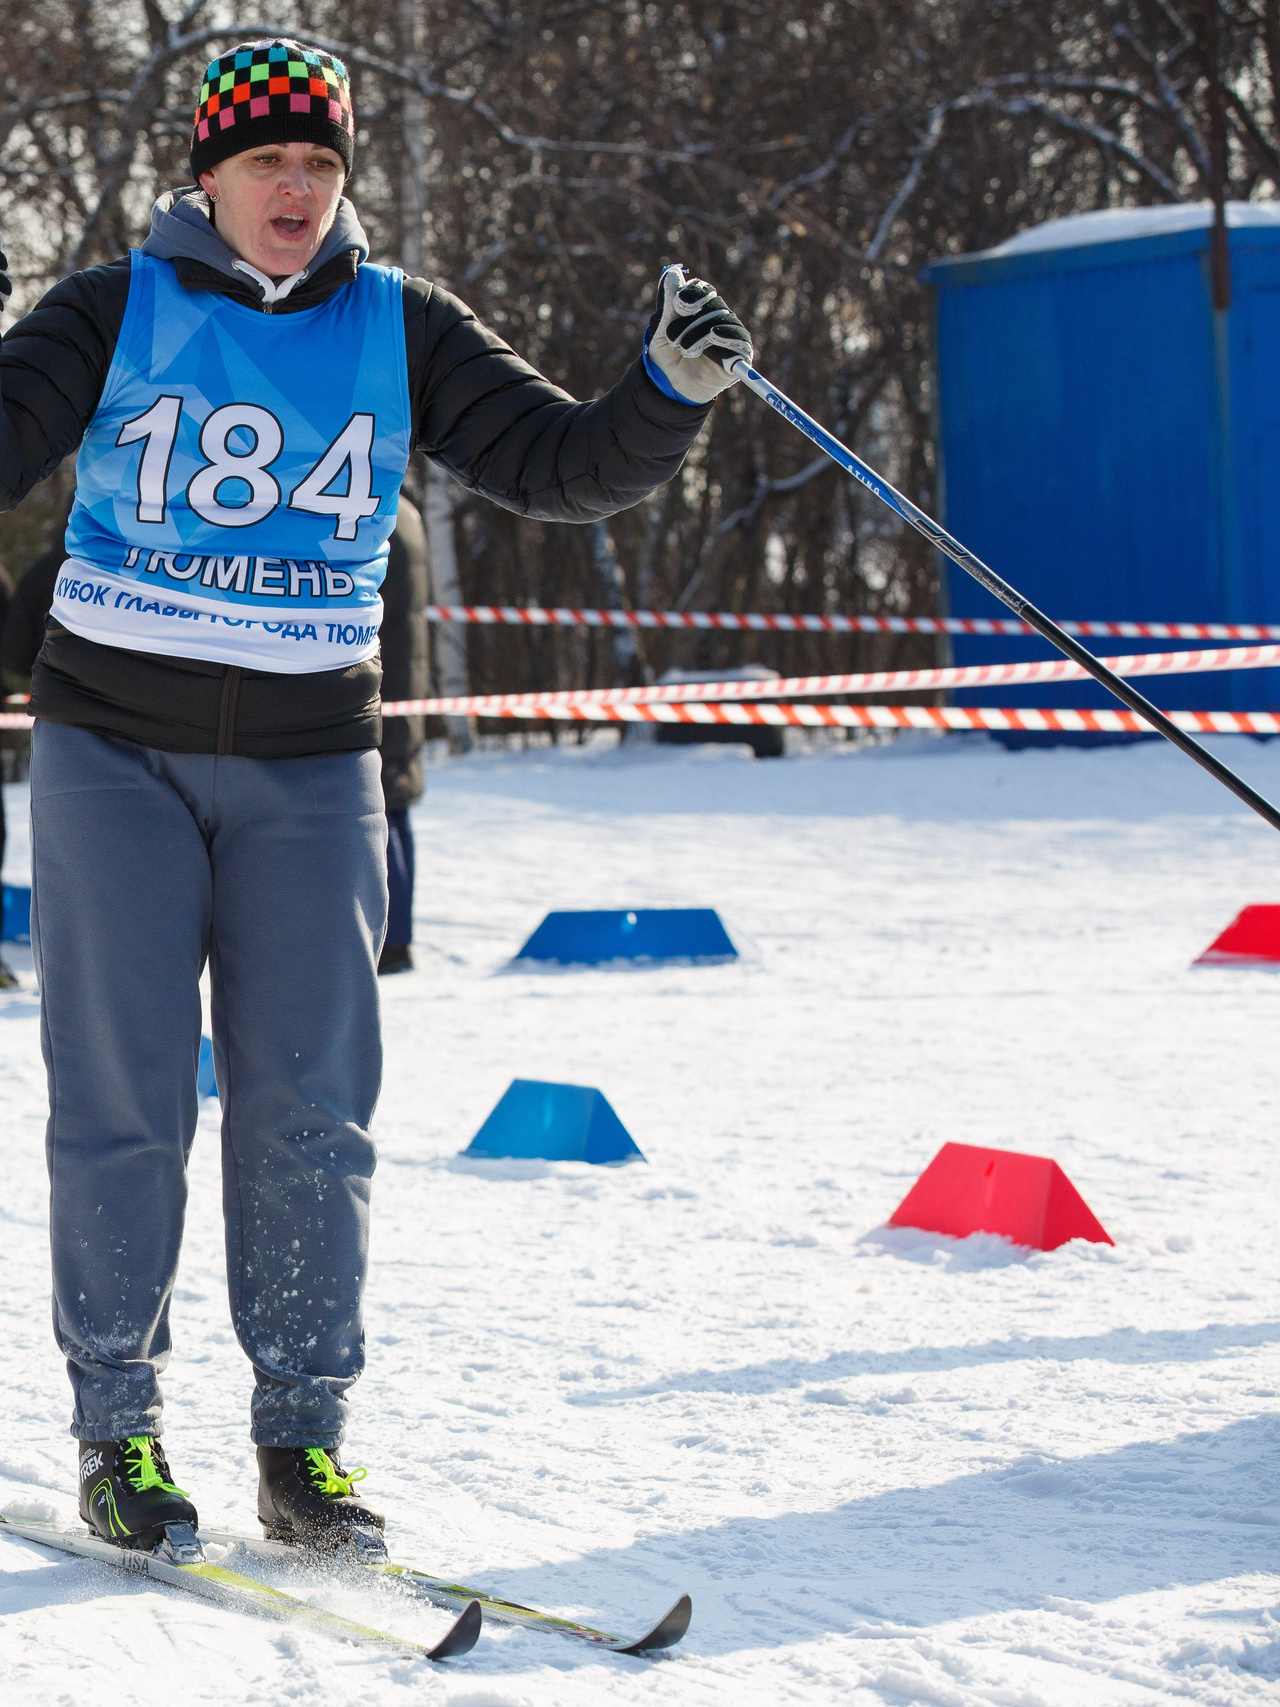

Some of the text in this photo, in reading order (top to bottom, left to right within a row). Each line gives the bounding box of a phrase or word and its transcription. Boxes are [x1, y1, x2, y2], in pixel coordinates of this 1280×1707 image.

[115, 394, 382, 542] 184
[56, 577, 111, 606] КУБОК
[325, 623, 380, 646] ТЮМЕ
